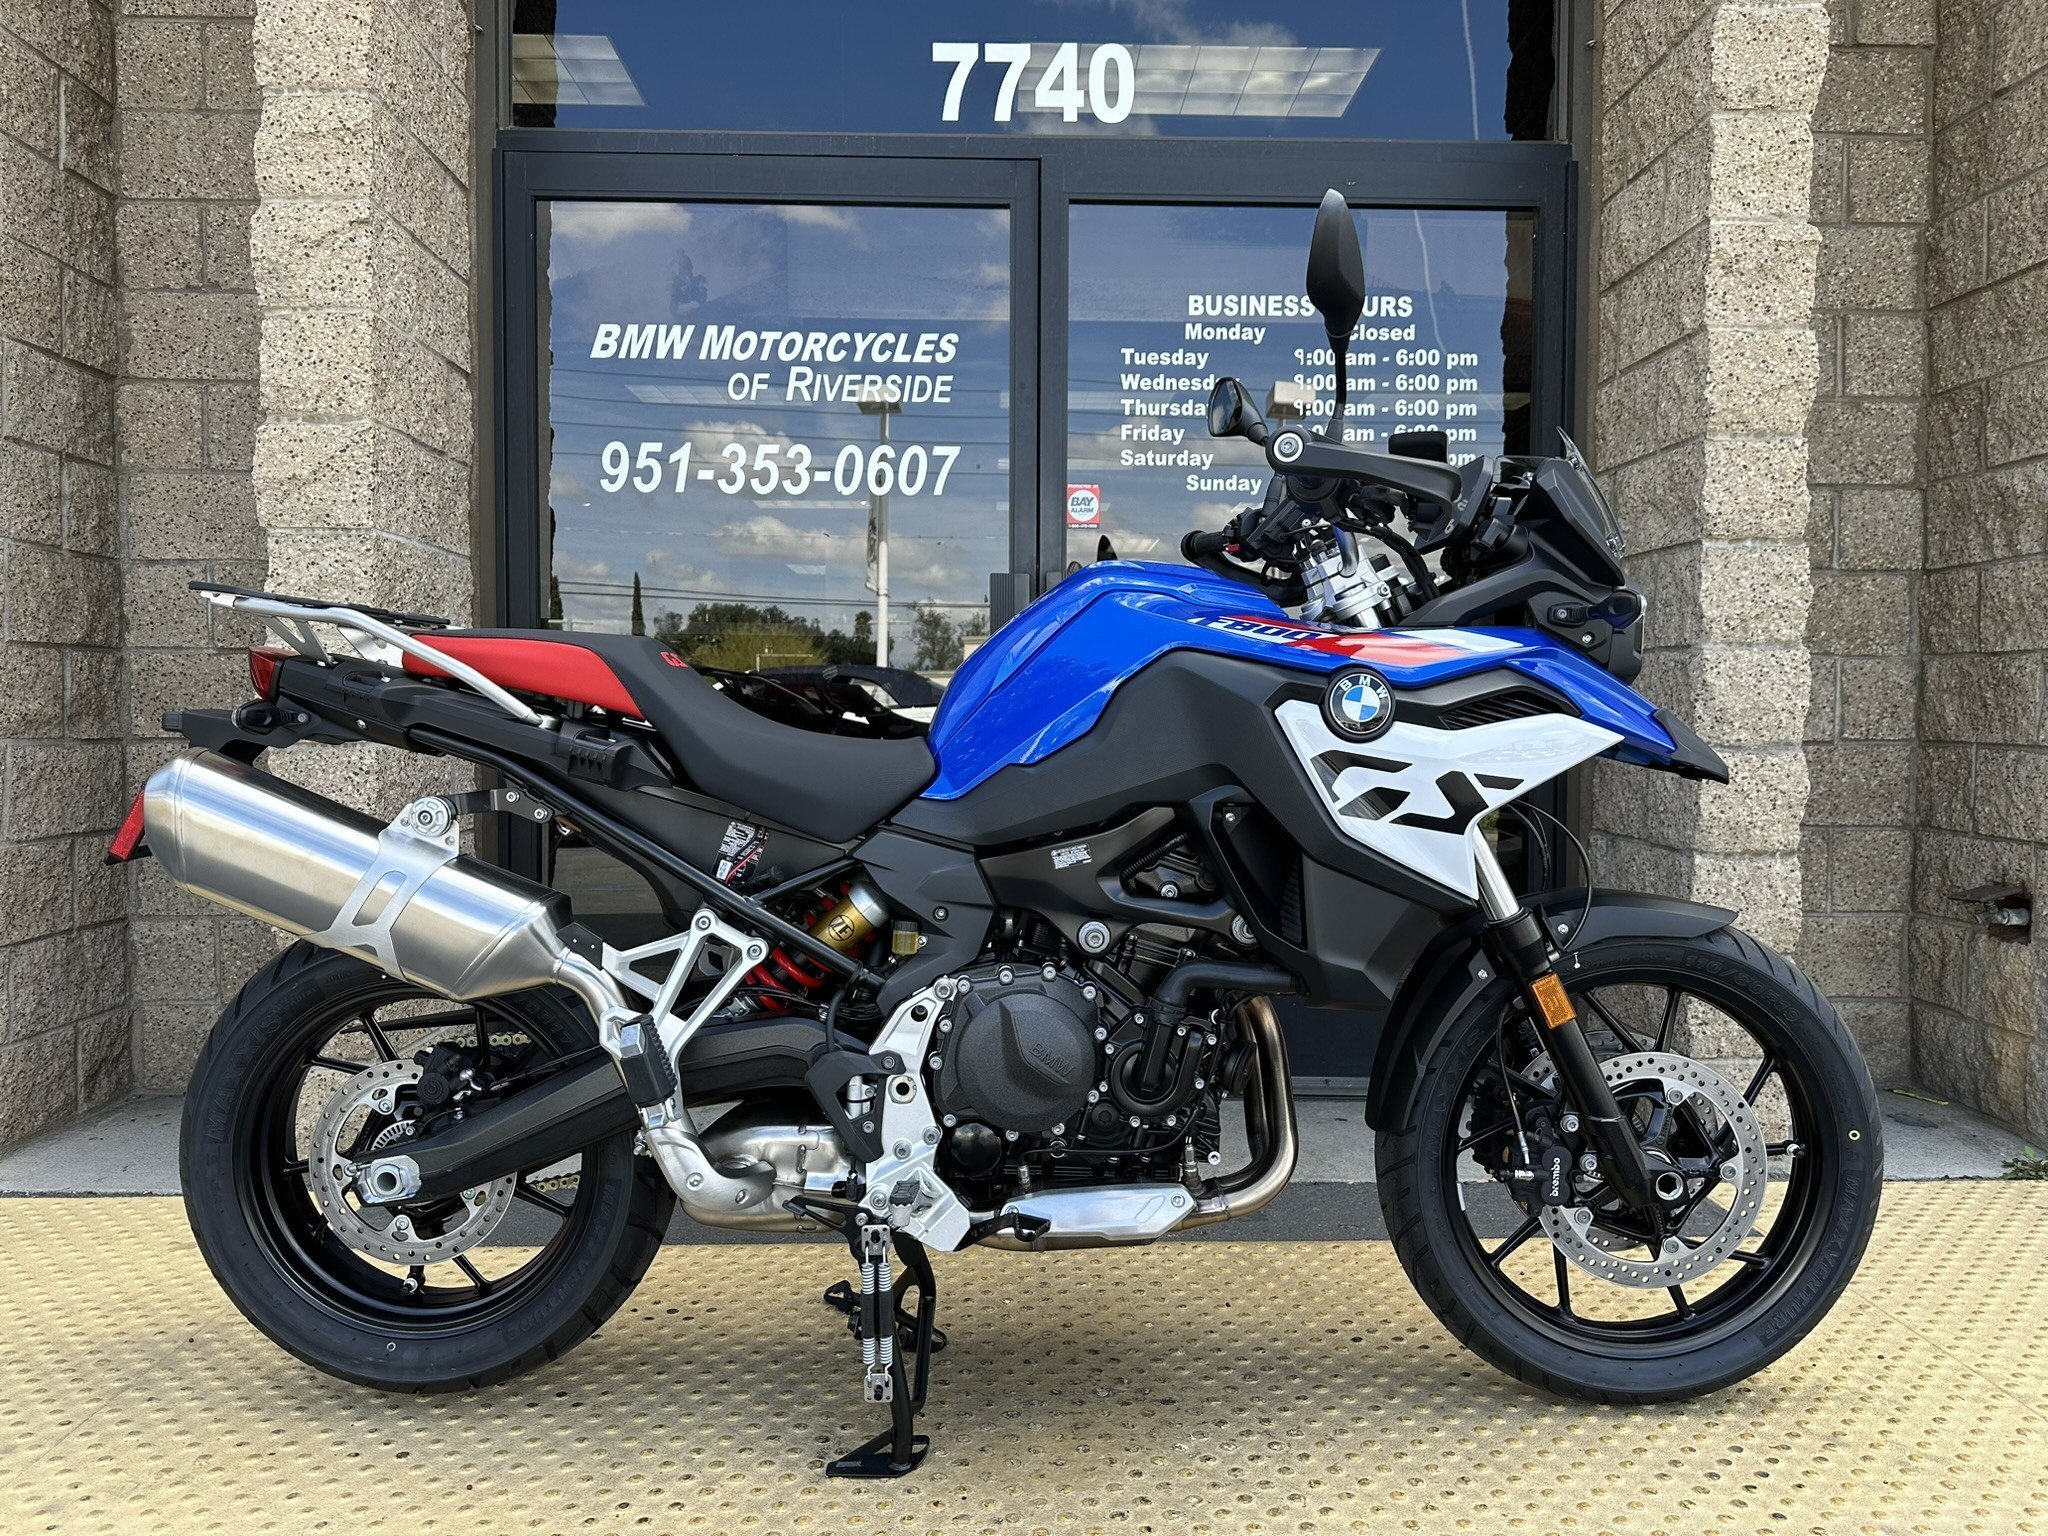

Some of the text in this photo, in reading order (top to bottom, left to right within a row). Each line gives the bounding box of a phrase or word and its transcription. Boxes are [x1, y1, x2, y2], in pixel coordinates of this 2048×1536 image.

[932, 42, 1135, 124] 7740
[1188, 294, 1414, 318] BUSINESS URS
[590, 323, 696, 360] BMW
[1185, 323, 1416, 345] Monday Closed
[1120, 348, 1210, 370] Tuesday
[1293, 348, 1336, 367] 9:00
[1345, 352, 1377, 367] am
[1395, 348, 1441, 367] 6:00
[1446, 353, 1479, 370] pm
[1120, 373, 1240, 391] Wednesd
[1293, 373, 1337, 392] 9:00
[1346, 378, 1377, 392] am
[1395, 374, 1441, 392] 6:00
[1446, 378, 1479, 396] pm
[1120, 398, 1209, 419] Thursda
[1293, 398, 1335, 417] 9:00
[1343, 403, 1376, 417] am
[1394, 399, 1440, 417] 6:00
[1446, 403, 1478, 421] pm
[1120, 424, 1186, 446] Friday
[1342, 428, 1375, 442] am
[1446, 428, 1478, 445] pm
[600, 440, 961, 495] 951-353-0607
[1120, 449, 1215, 471] Saturday
[1186, 474, 1263, 496] Sunday
[1070, 496, 1095, 507] BAY
[1340, 675, 1390, 699] BMW
[1028, 1042, 1075, 1077] BMW
[1549, 1156, 1561, 1197] brembo
